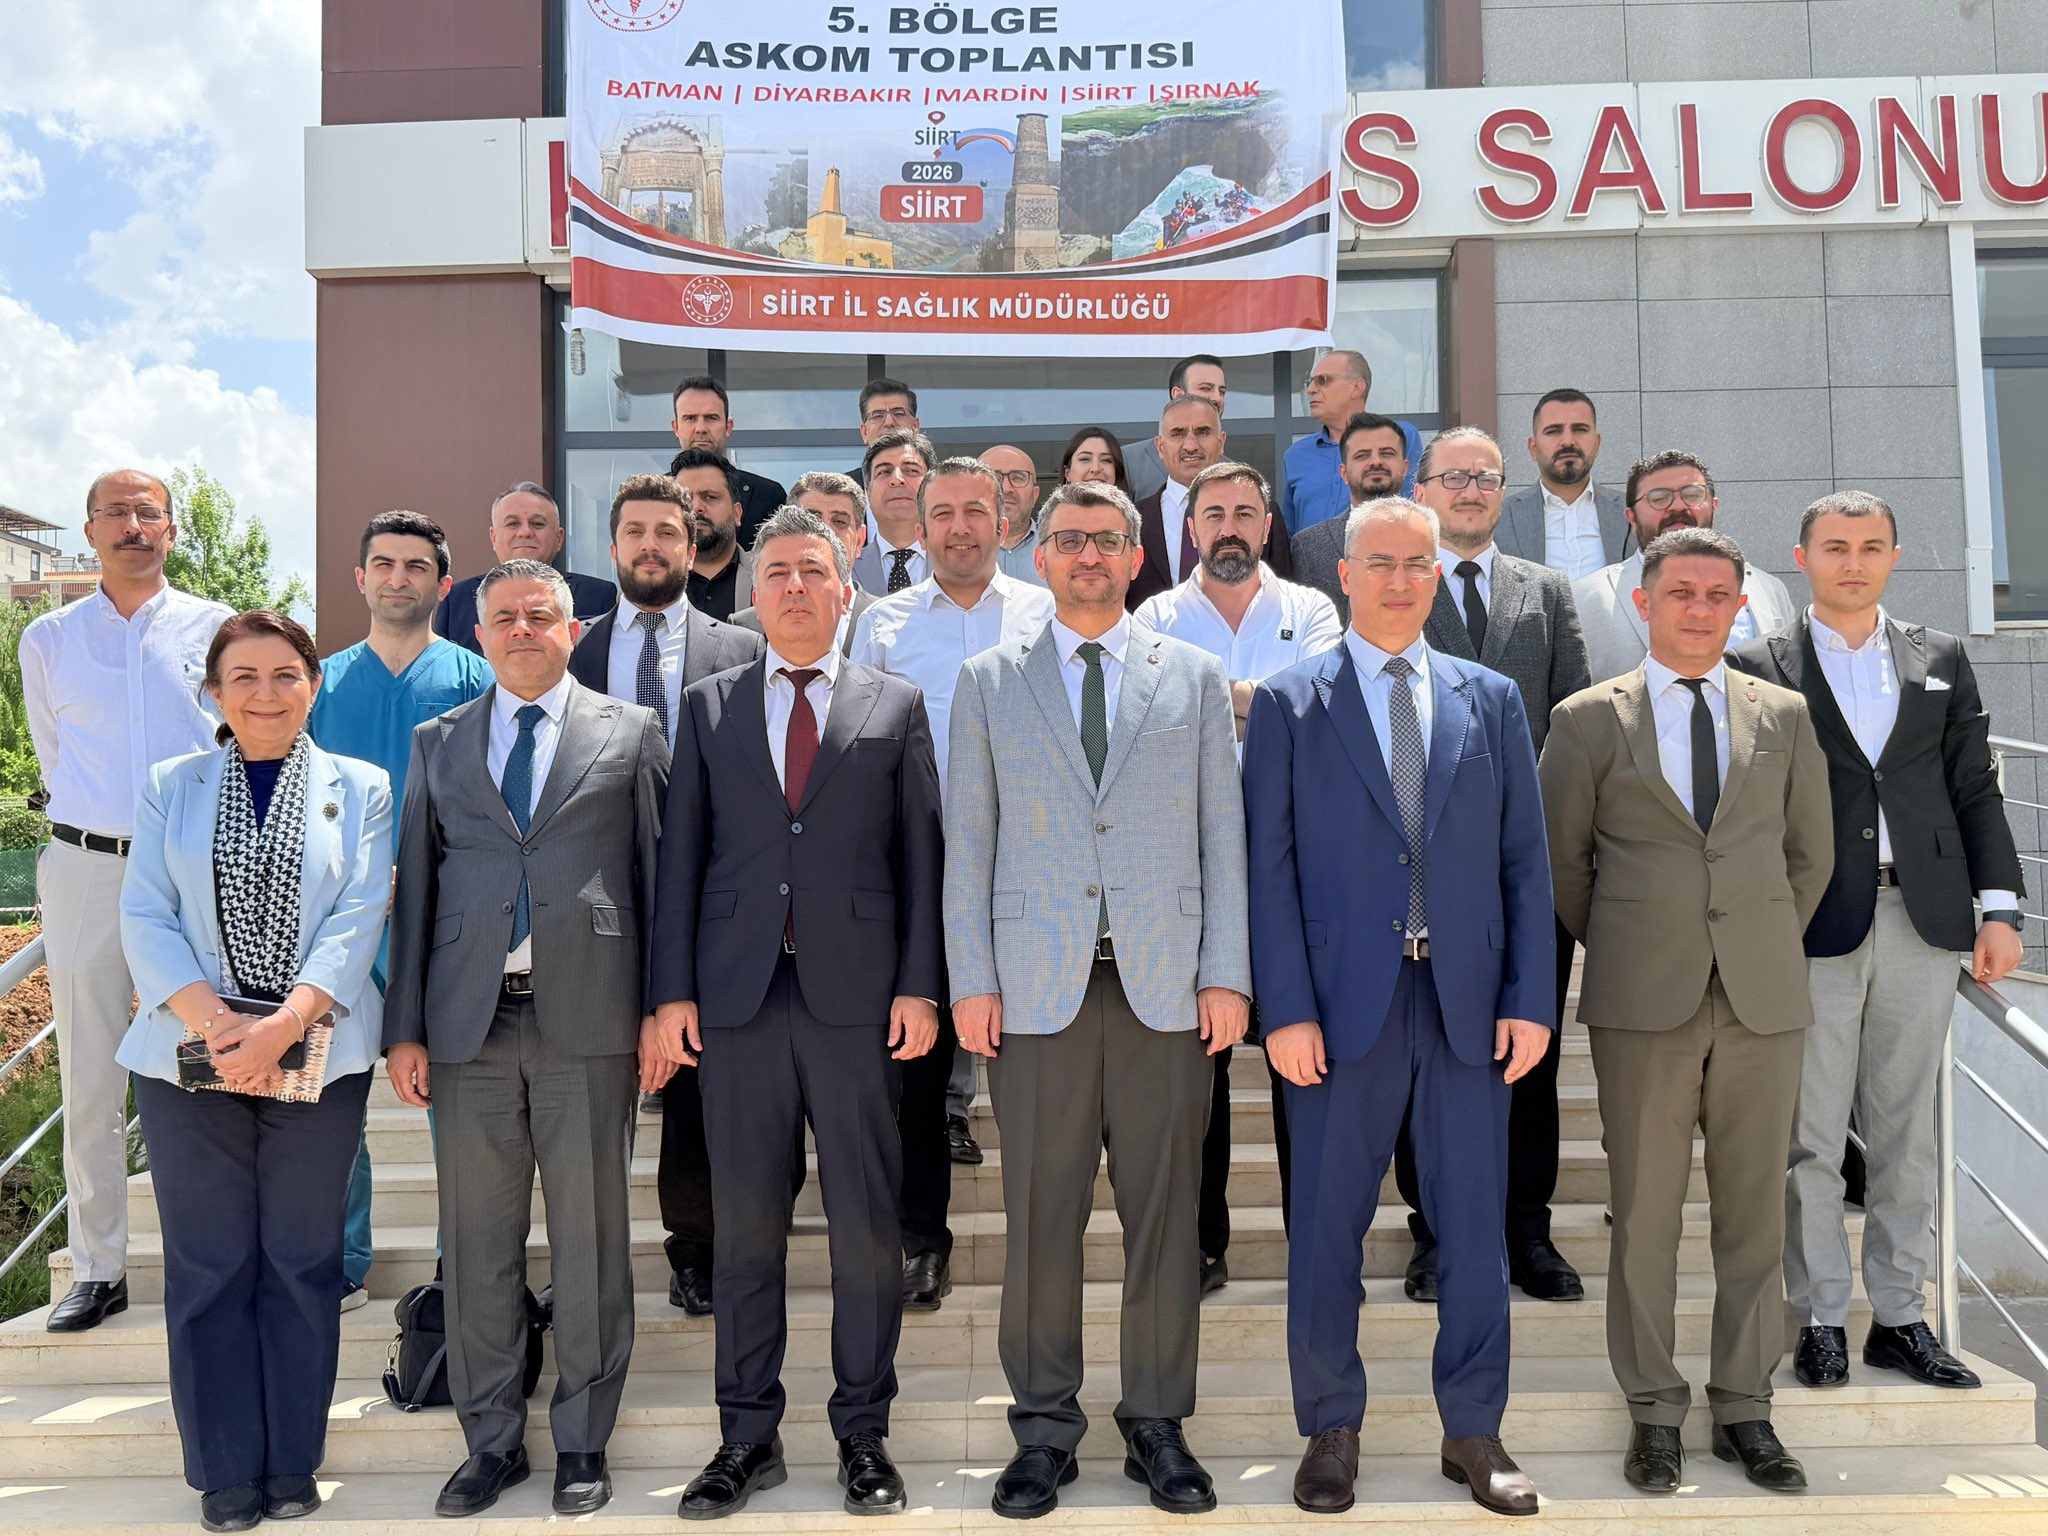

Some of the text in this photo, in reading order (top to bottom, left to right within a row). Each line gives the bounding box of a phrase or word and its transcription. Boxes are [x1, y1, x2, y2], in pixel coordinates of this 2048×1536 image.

[828, 3, 1058, 35] 5. BÖLGE
[684, 41, 1194, 73] ASKOM TOPLANTISI
[607, 79, 723, 101] BATMAN
[753, 83, 911, 103] DİYARBAKIR
[914, 128, 961, 146] SİİRT
[911, 164, 953, 181] 2026
[1475, 93, 2048, 224] SALONU
[900, 189, 967, 219] SİİRT
[762, 289, 1171, 320] SİİRT İL SAĞLIK MÜDÜRLÜĞÜ
